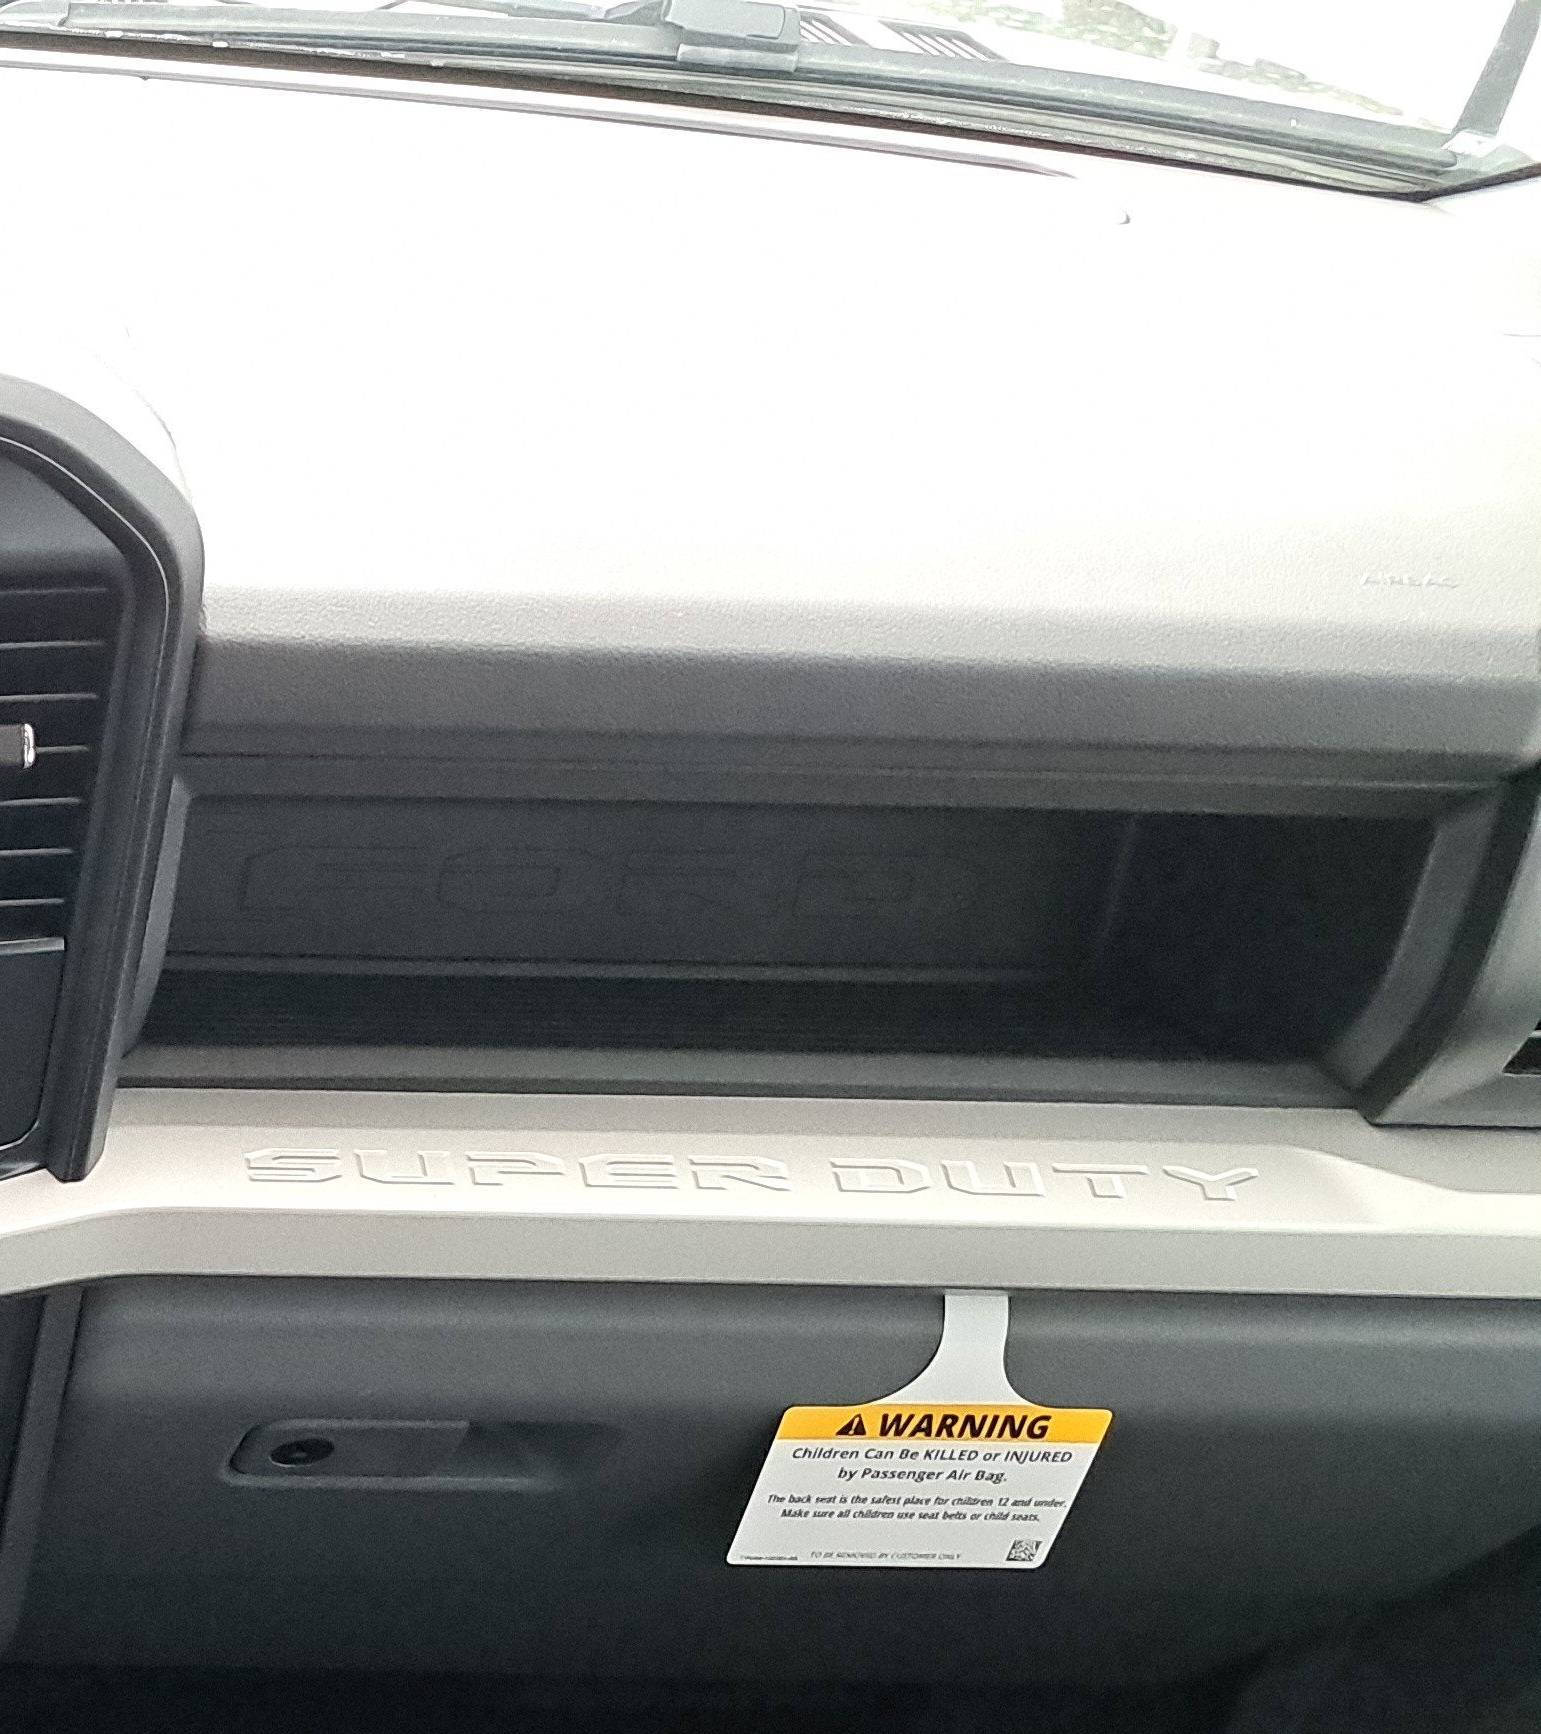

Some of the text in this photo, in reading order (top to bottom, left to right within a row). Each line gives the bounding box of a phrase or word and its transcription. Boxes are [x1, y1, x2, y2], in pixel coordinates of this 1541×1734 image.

[243, 1147, 1260, 1201] SUPER DUTY
[879, 1413, 1052, 1439] WARNING
[792, 1447, 1073, 1465] Children Can Be KILLED or INJURED
[838, 1467, 1008, 1485] by Passenger Air Bag.
[768, 1494, 785, 1503] The
[788, 1494, 811, 1503] back
[816, 1495, 836, 1504] seat
[839, 1495, 847, 1504] is
[850, 1495, 867, 1504] the
[871, 1495, 900, 1505] safest
[903, 1496, 930, 1508] place
[934, 1496, 948, 1506] for
[952, 1496, 993, 1507] children
[998, 1497, 1010, 1507] 12
[1011, 1497, 1033, 1507] and
[781, 1509, 809, 1518] Make
[813, 1510, 835, 1519] sure
[837, 1509, 851, 1519] all
[853, 1509, 894, 1519] children
[897, 1511, 915, 1520] use
[918, 1511, 940, 1520] seat
[970, 1512, 981, 1521] or
[984, 1511, 1010, 1521] child
